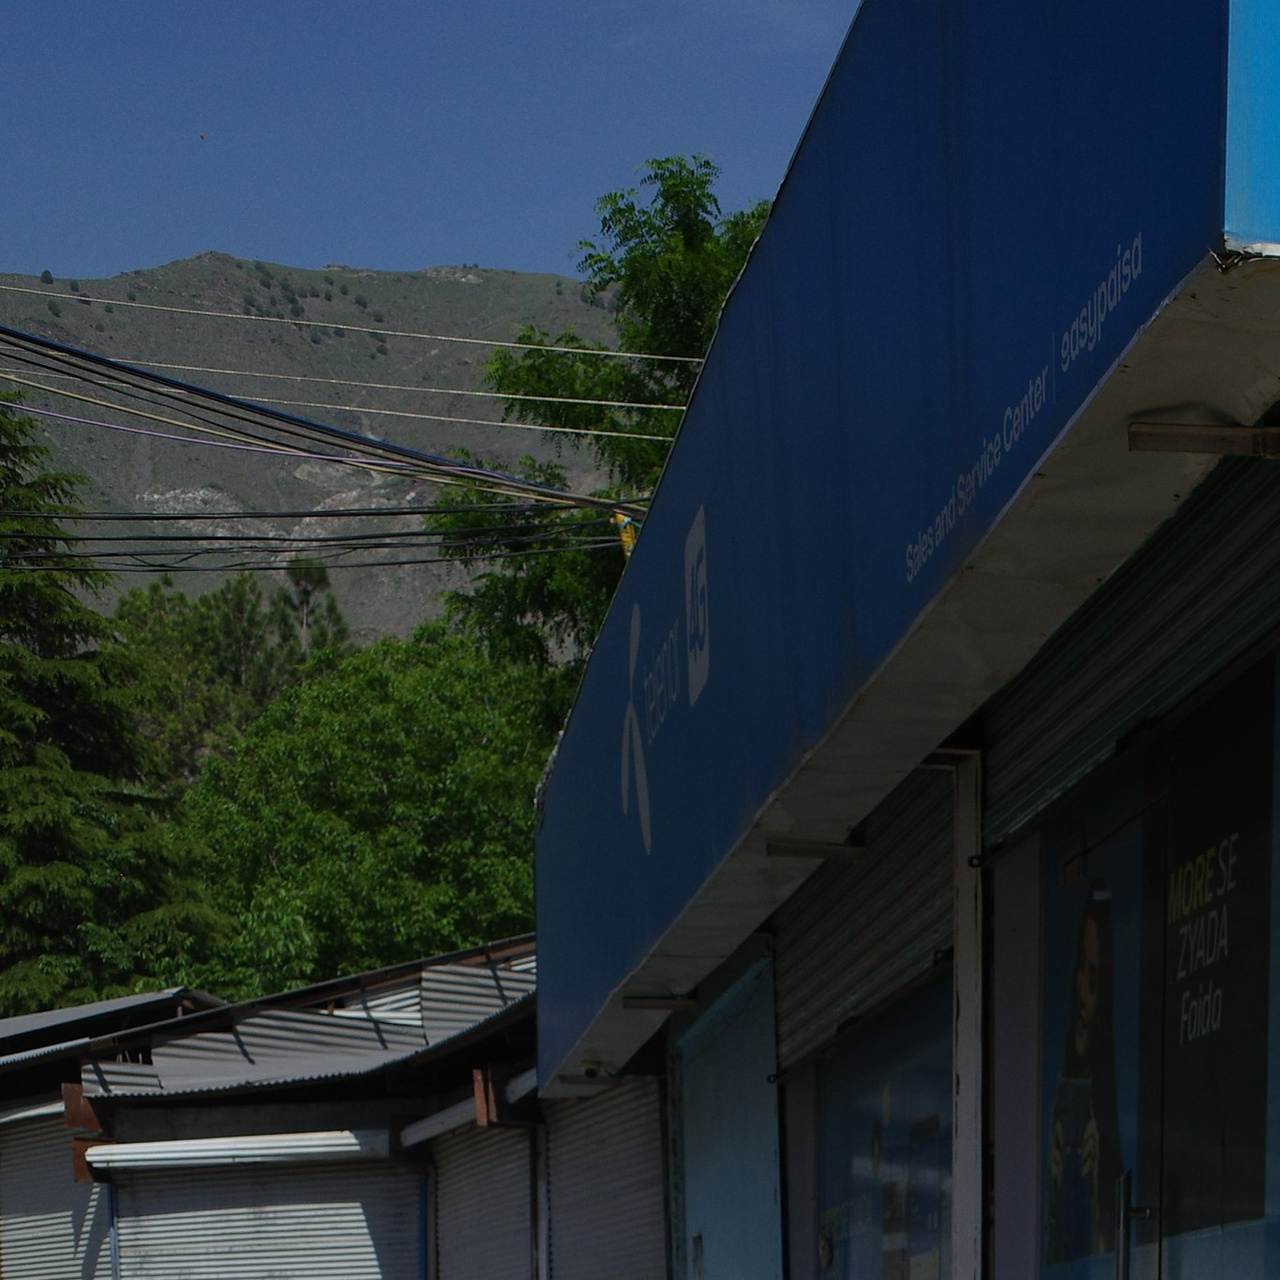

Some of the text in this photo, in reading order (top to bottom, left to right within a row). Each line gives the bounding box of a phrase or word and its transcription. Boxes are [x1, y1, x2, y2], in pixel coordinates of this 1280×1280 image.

[905, 232, 1143, 583] Sales and Service Center easypaisa
[1167, 832, 1239, 924] MORE SE
[1176, 903, 1229, 980] ZYADA
[1178, 978, 1223, 1049] Faida
